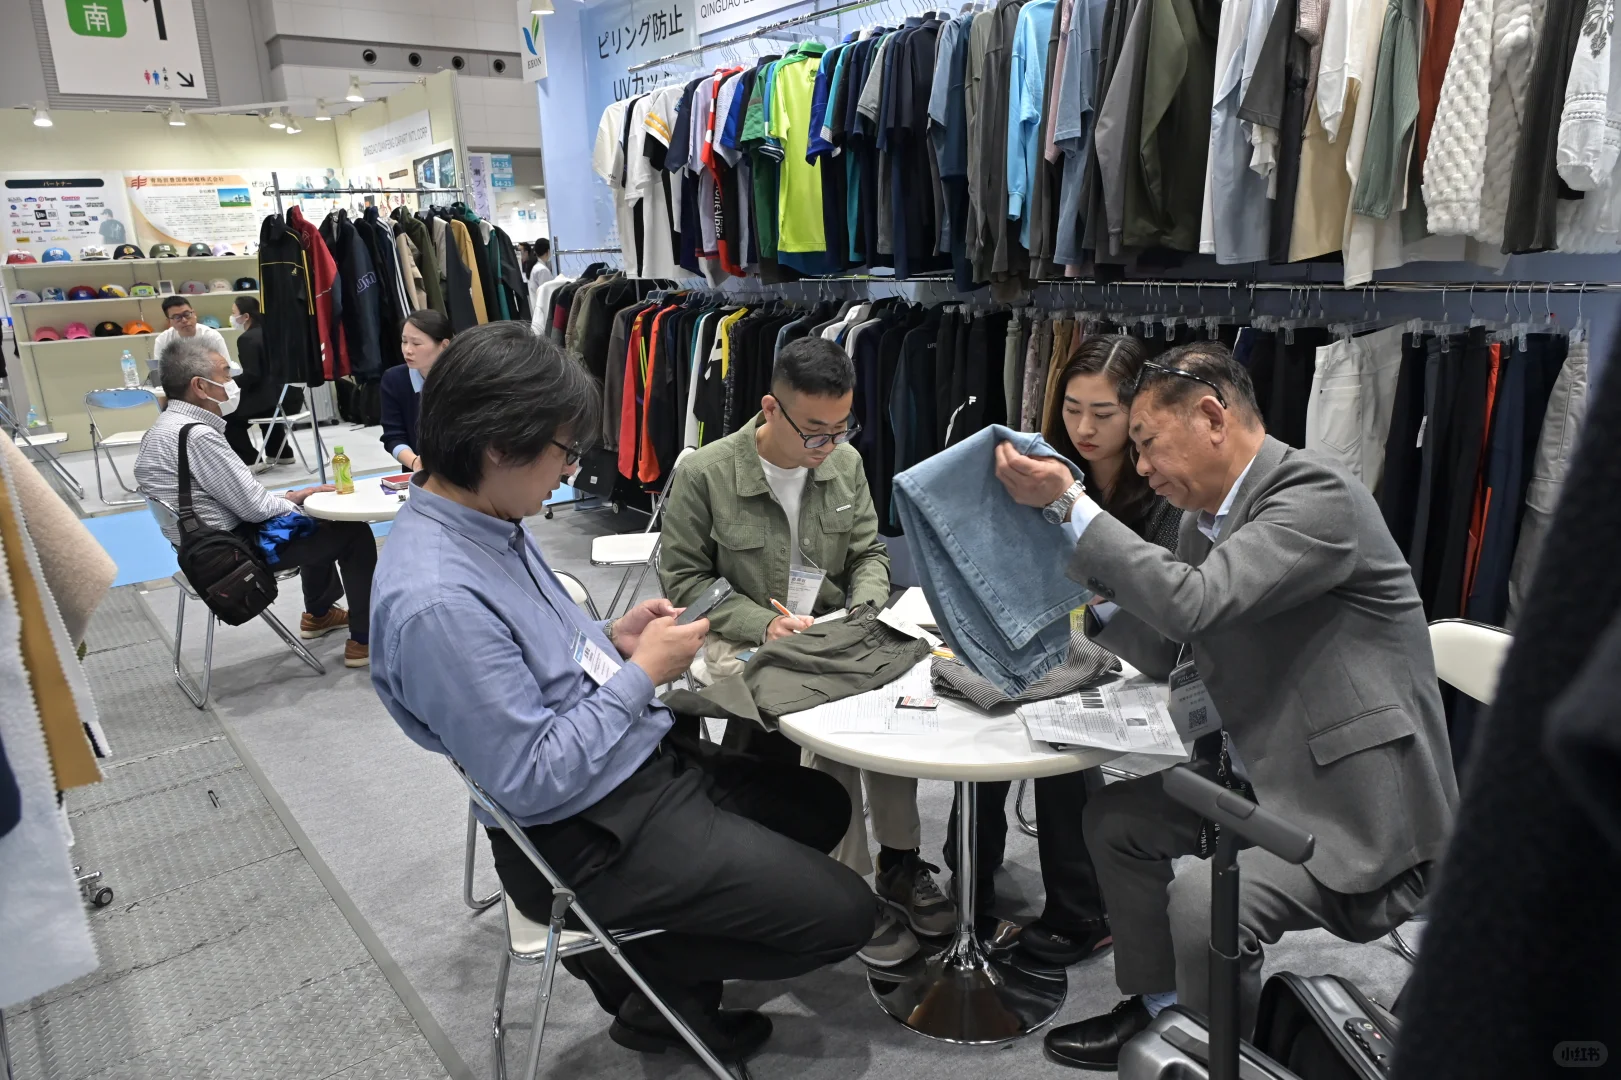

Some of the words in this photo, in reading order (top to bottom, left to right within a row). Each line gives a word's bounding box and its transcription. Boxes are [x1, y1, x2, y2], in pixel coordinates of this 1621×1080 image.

[82, 2, 111, 33] 南
[598, 3, 684, 59] ピリング防止
